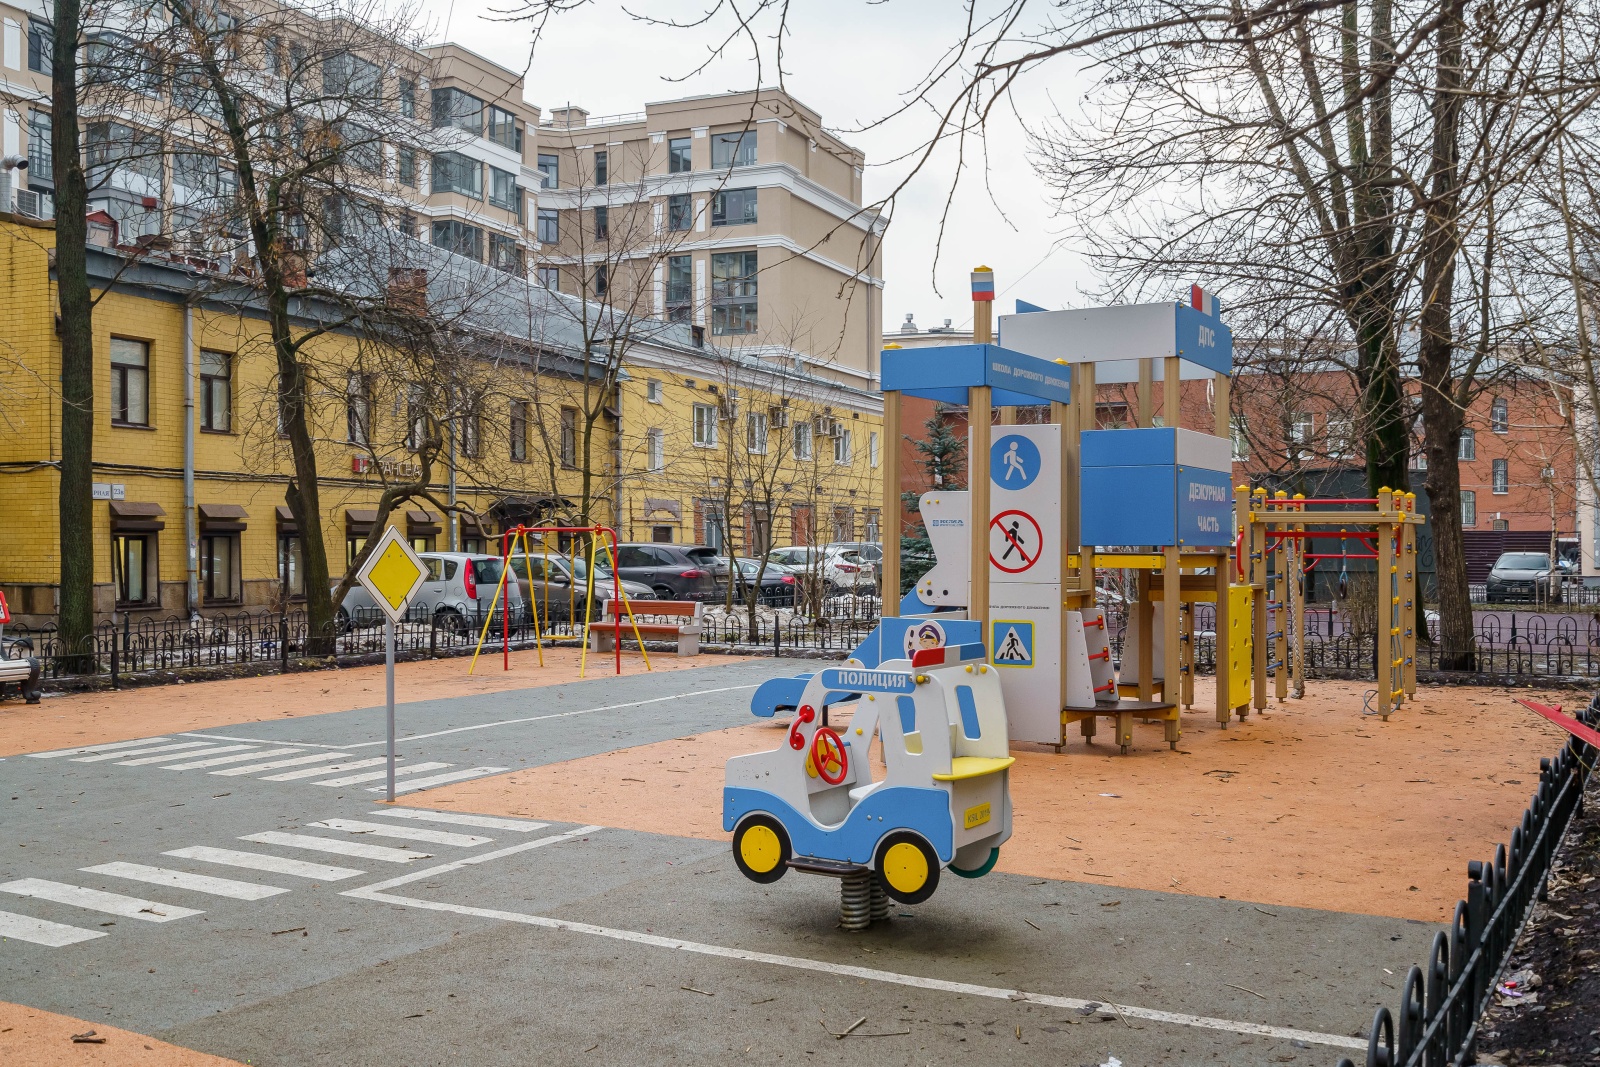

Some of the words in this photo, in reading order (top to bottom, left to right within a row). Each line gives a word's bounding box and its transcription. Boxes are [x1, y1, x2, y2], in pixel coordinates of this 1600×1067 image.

[1198, 324, 1215, 348] ДПС
[992, 362, 1012, 375] ШКОЛА
[1012, 367, 1044, 383] ДОРОЖНОГО
[1044, 375, 1070, 390] ДВИЖЕНИЯ
[1188, 482, 1226, 502] ДЕЖУРНАЯ
[1197, 515, 1220, 533] ЧАСТЬ
[838, 671, 906, 690] ПОЛИЦИЯ
